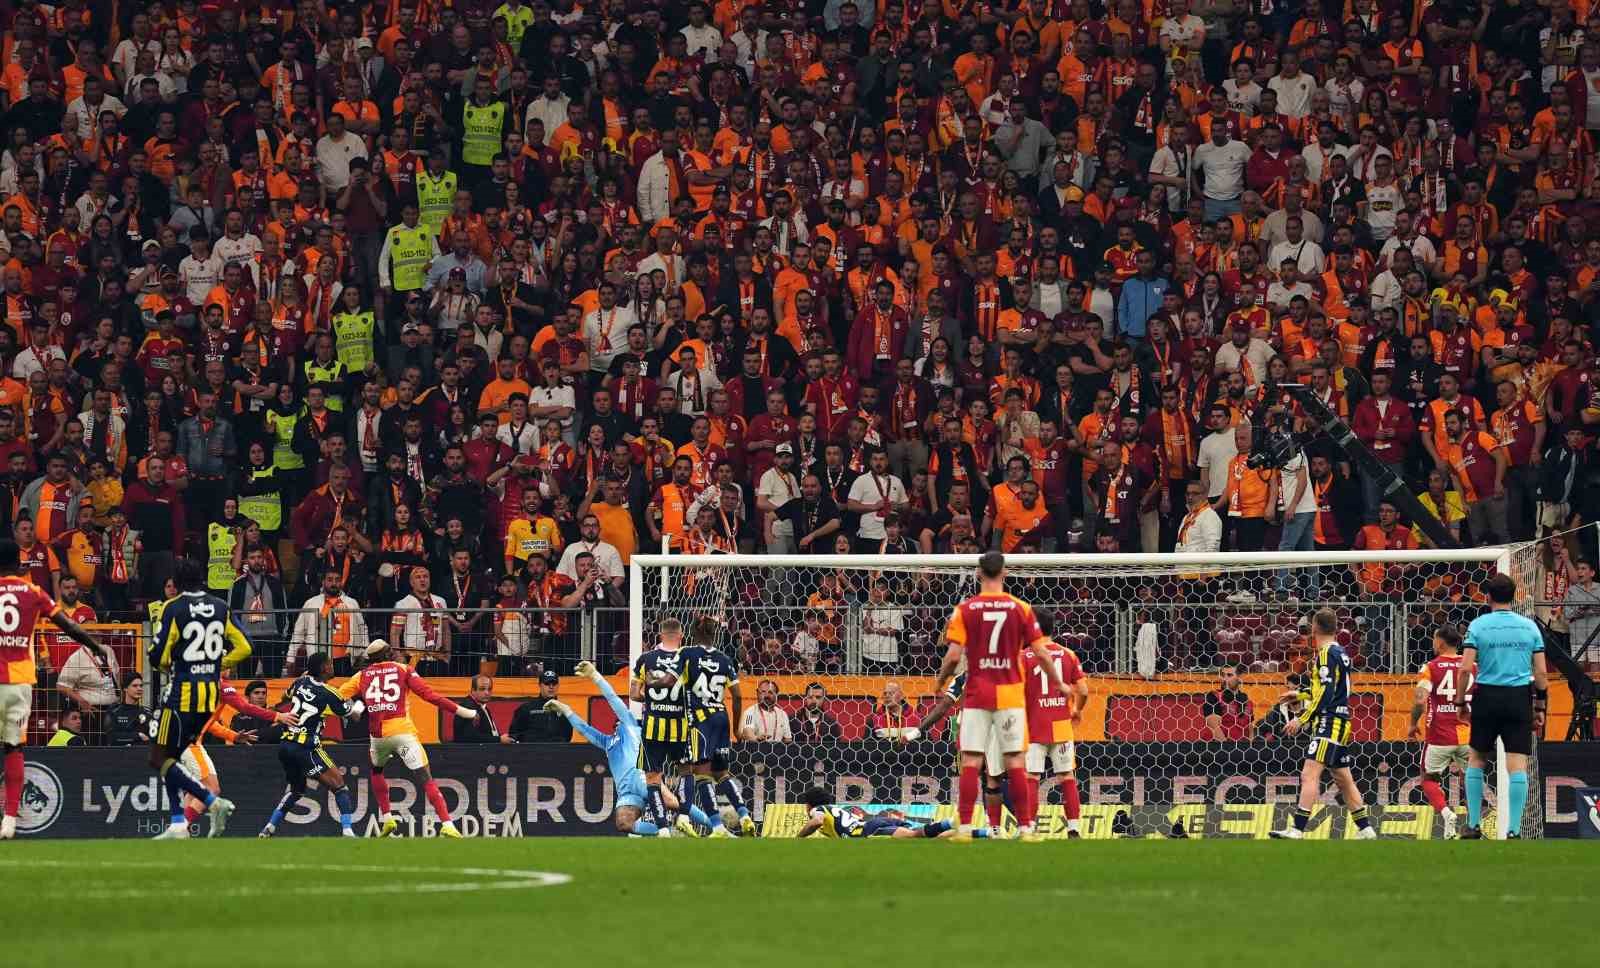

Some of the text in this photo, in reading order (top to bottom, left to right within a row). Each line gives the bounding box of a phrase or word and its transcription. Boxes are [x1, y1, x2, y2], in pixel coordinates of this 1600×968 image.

[182, 620, 225, 662] 26
[982, 610, 1008, 655] 7
[365, 672, 401, 703] 45
[1037, 697, 1067, 708] YUNUS
[365, 811, 524, 839] ACIBDEM
